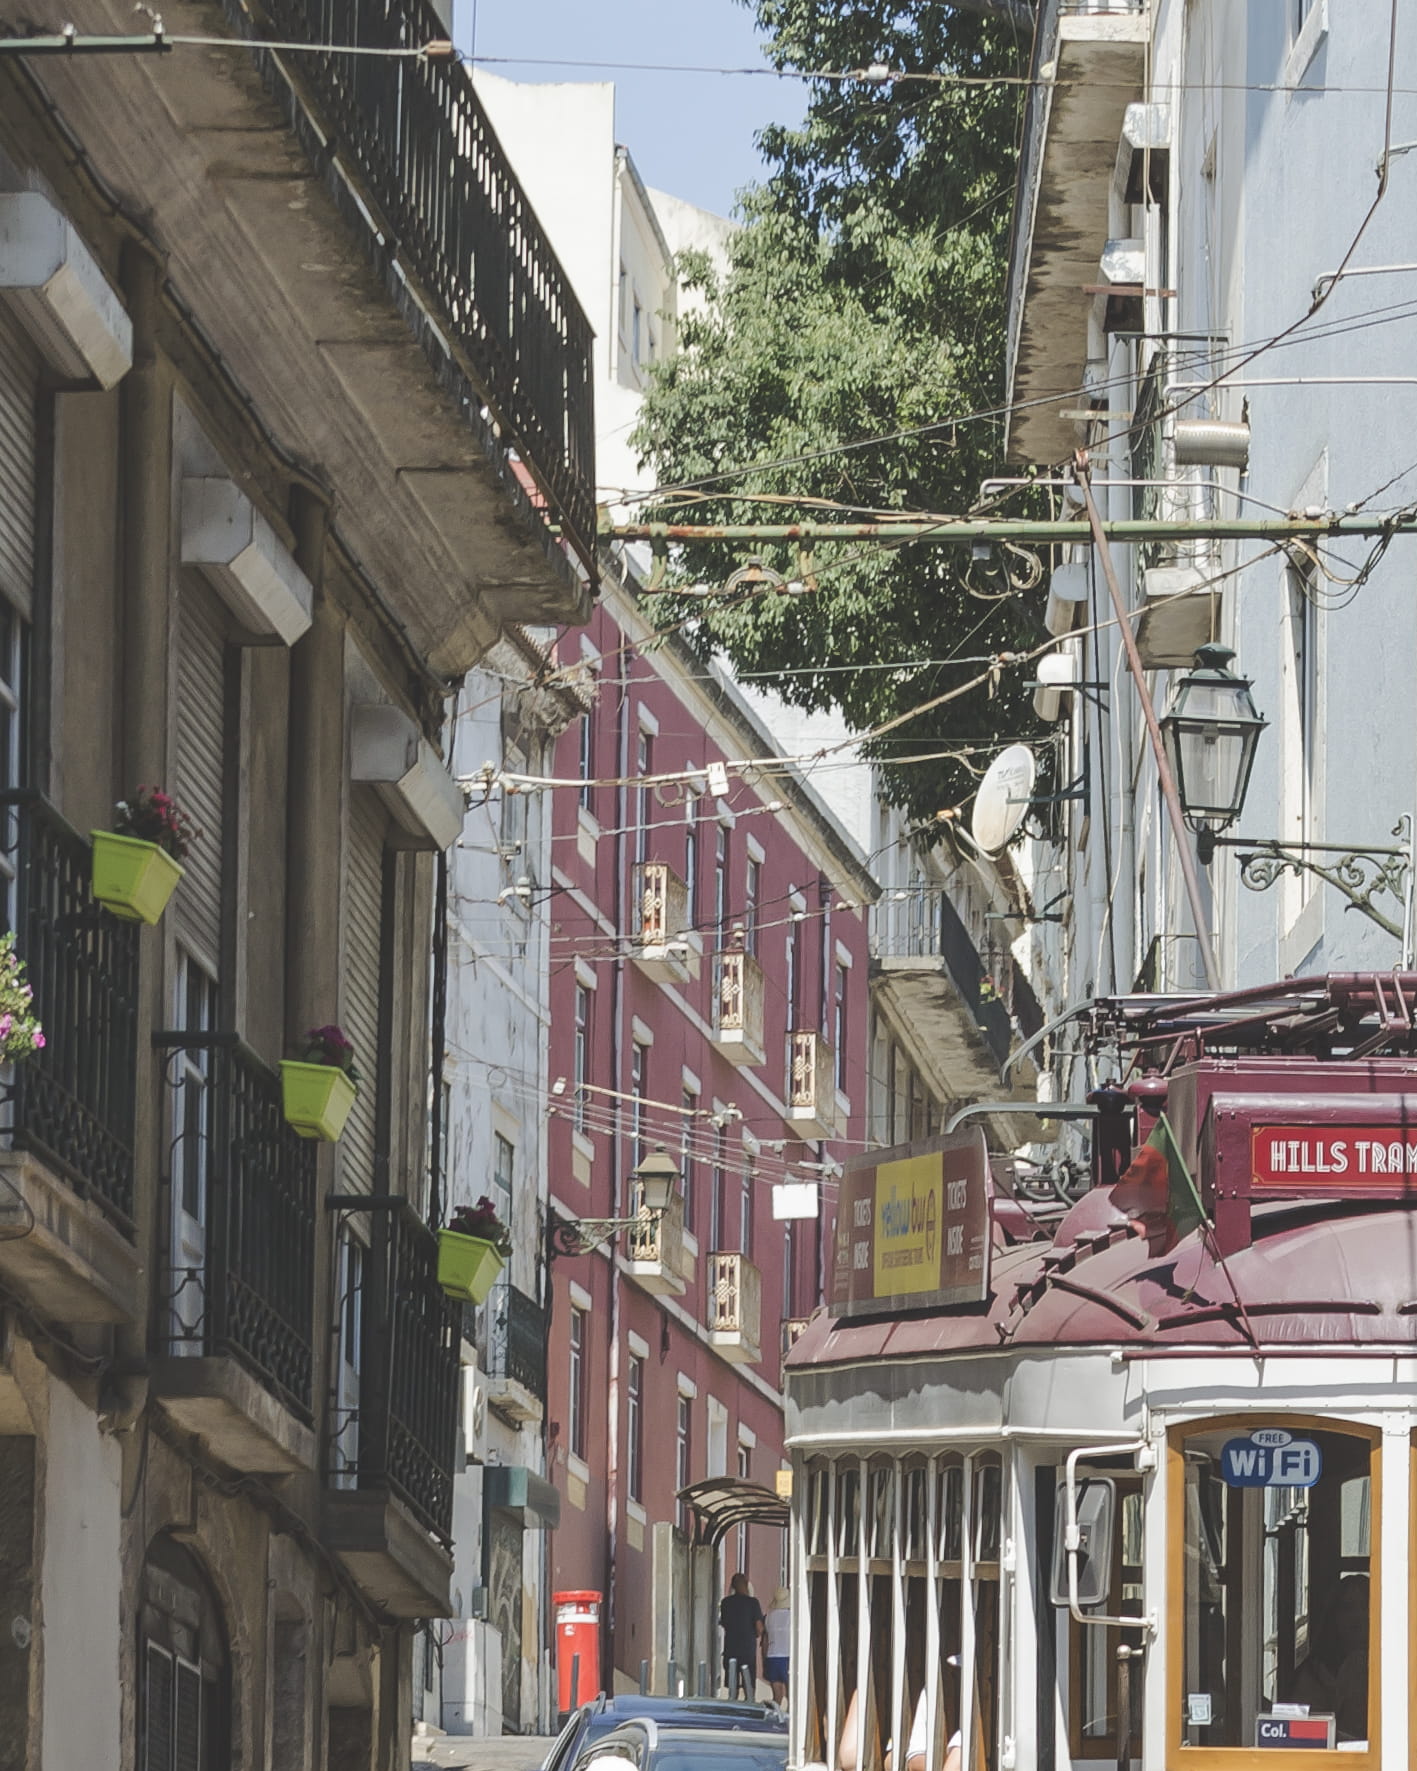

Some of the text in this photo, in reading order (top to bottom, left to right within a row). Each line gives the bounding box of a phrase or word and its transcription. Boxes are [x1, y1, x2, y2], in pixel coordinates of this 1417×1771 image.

[1269, 1140, 1348, 1173] HILLS
[947, 1179, 967, 1211] TICKETS
[853, 1198, 872, 1227] TICKETS
[947, 1224, 964, 1256] INSIDE
[853, 1241, 870, 1270] INSIDE
[1258, 1433, 1285, 1444] FREE
[1261, 1723, 1287, 1738] Col.
